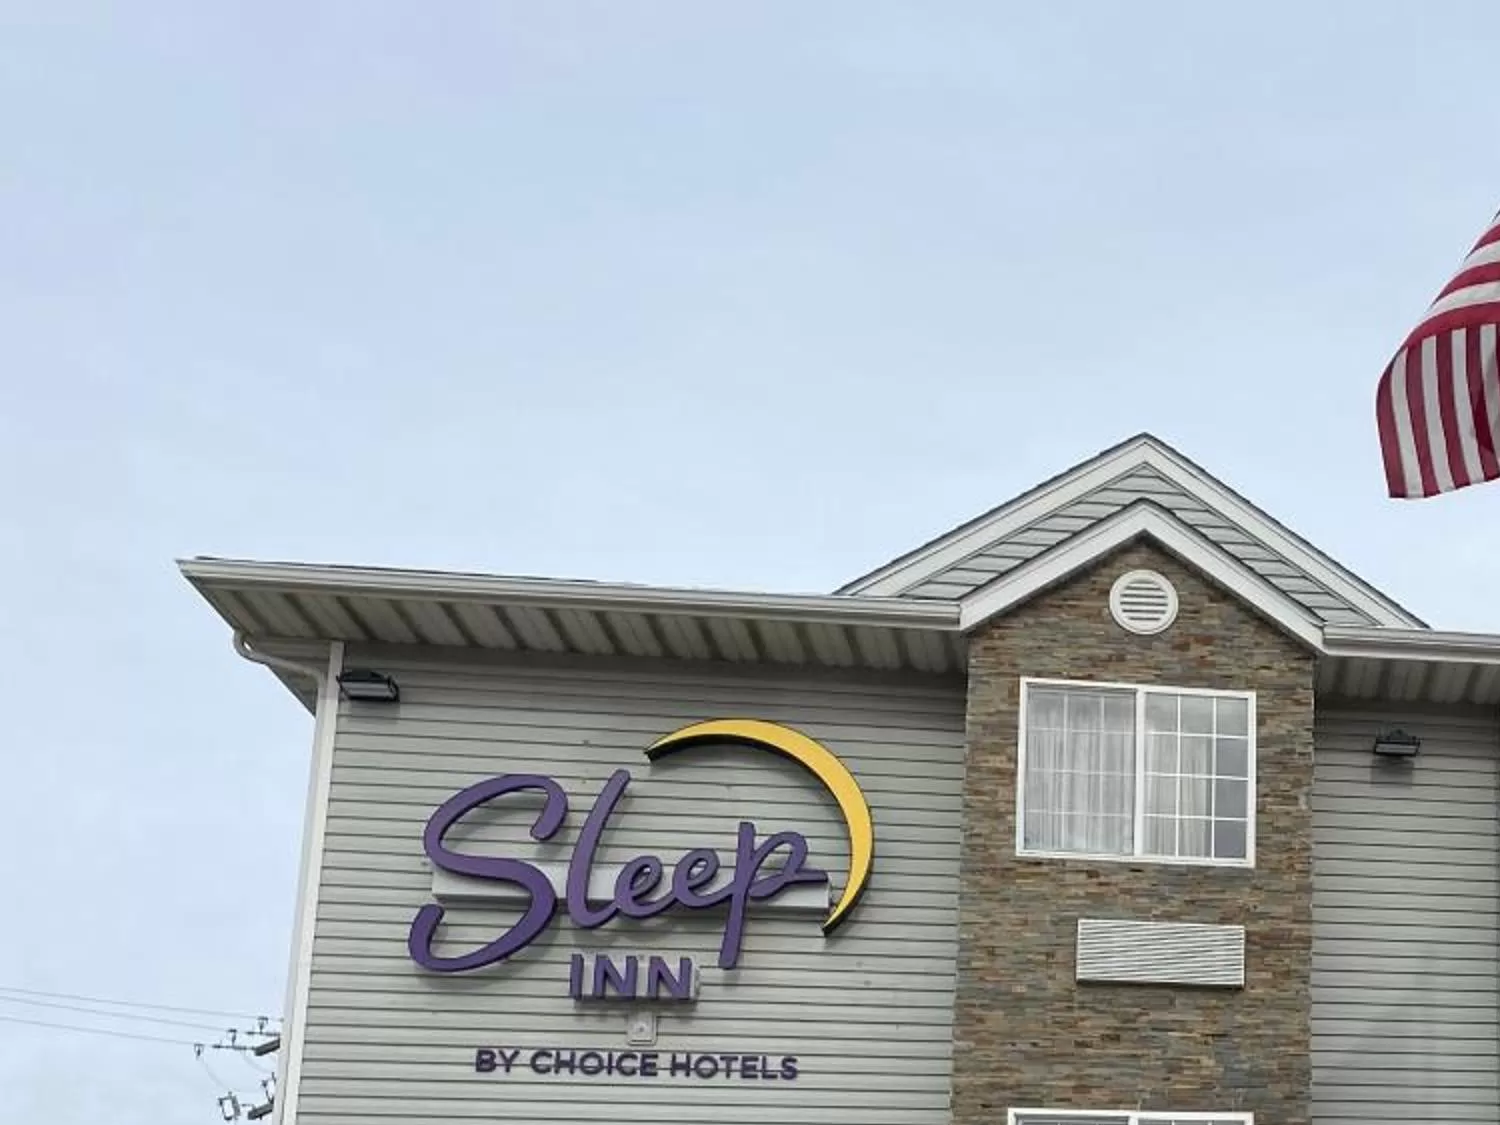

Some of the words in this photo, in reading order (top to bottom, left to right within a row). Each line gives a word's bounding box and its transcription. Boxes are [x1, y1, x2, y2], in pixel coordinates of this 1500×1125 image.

[408, 768, 828, 973] Sleep
[568, 953, 694, 1000] INN
[475, 1048, 520, 1074] BY
[529, 1050, 659, 1077] CHOICE
[669, 1052, 799, 1080] HOTELS
